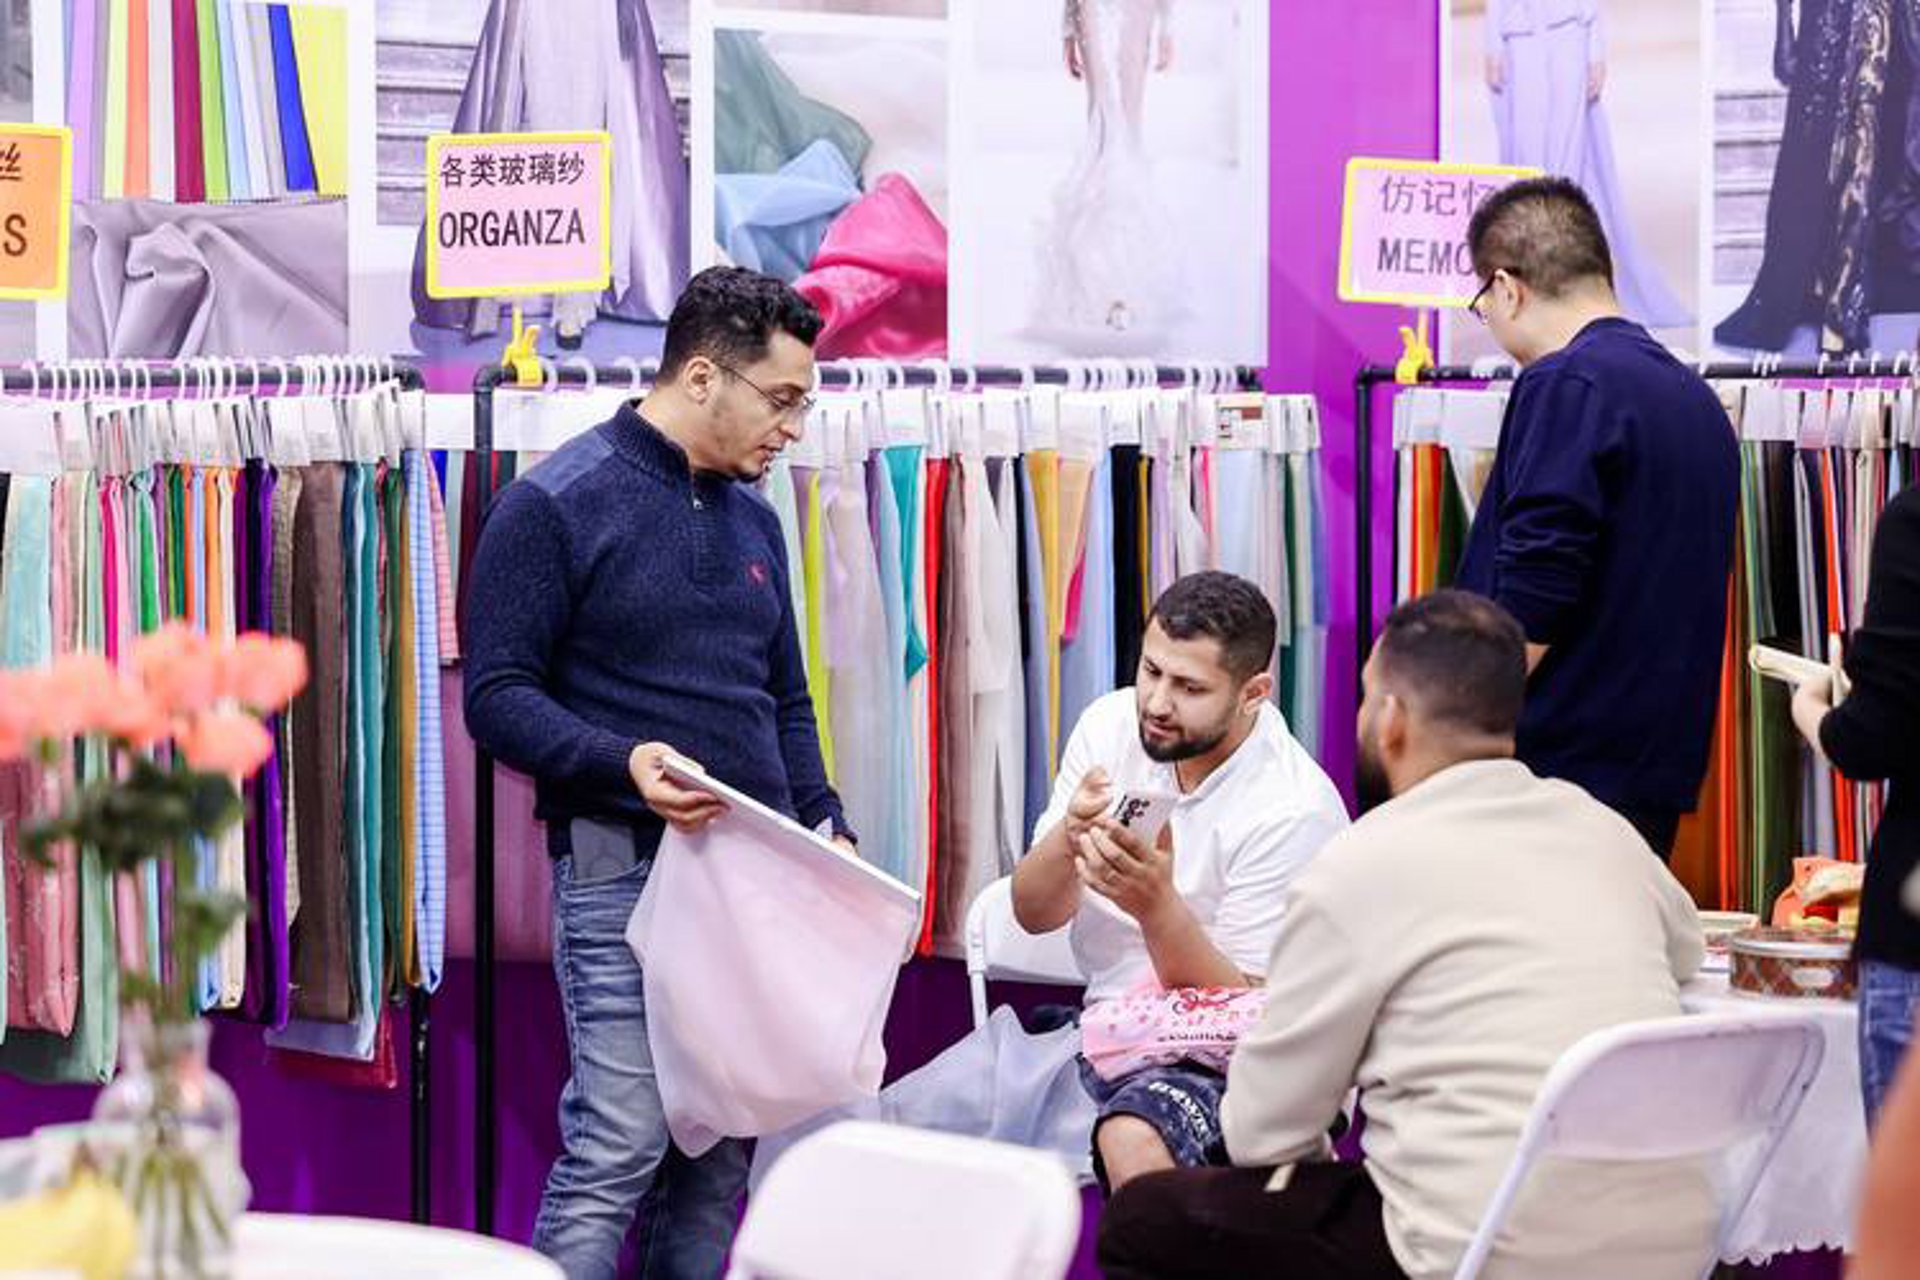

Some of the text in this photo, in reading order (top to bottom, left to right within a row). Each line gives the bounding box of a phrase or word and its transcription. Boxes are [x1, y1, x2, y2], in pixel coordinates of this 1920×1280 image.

[441, 151, 585, 188] 各类玻璃纱
[439, 208, 586, 248] ORGANZA
